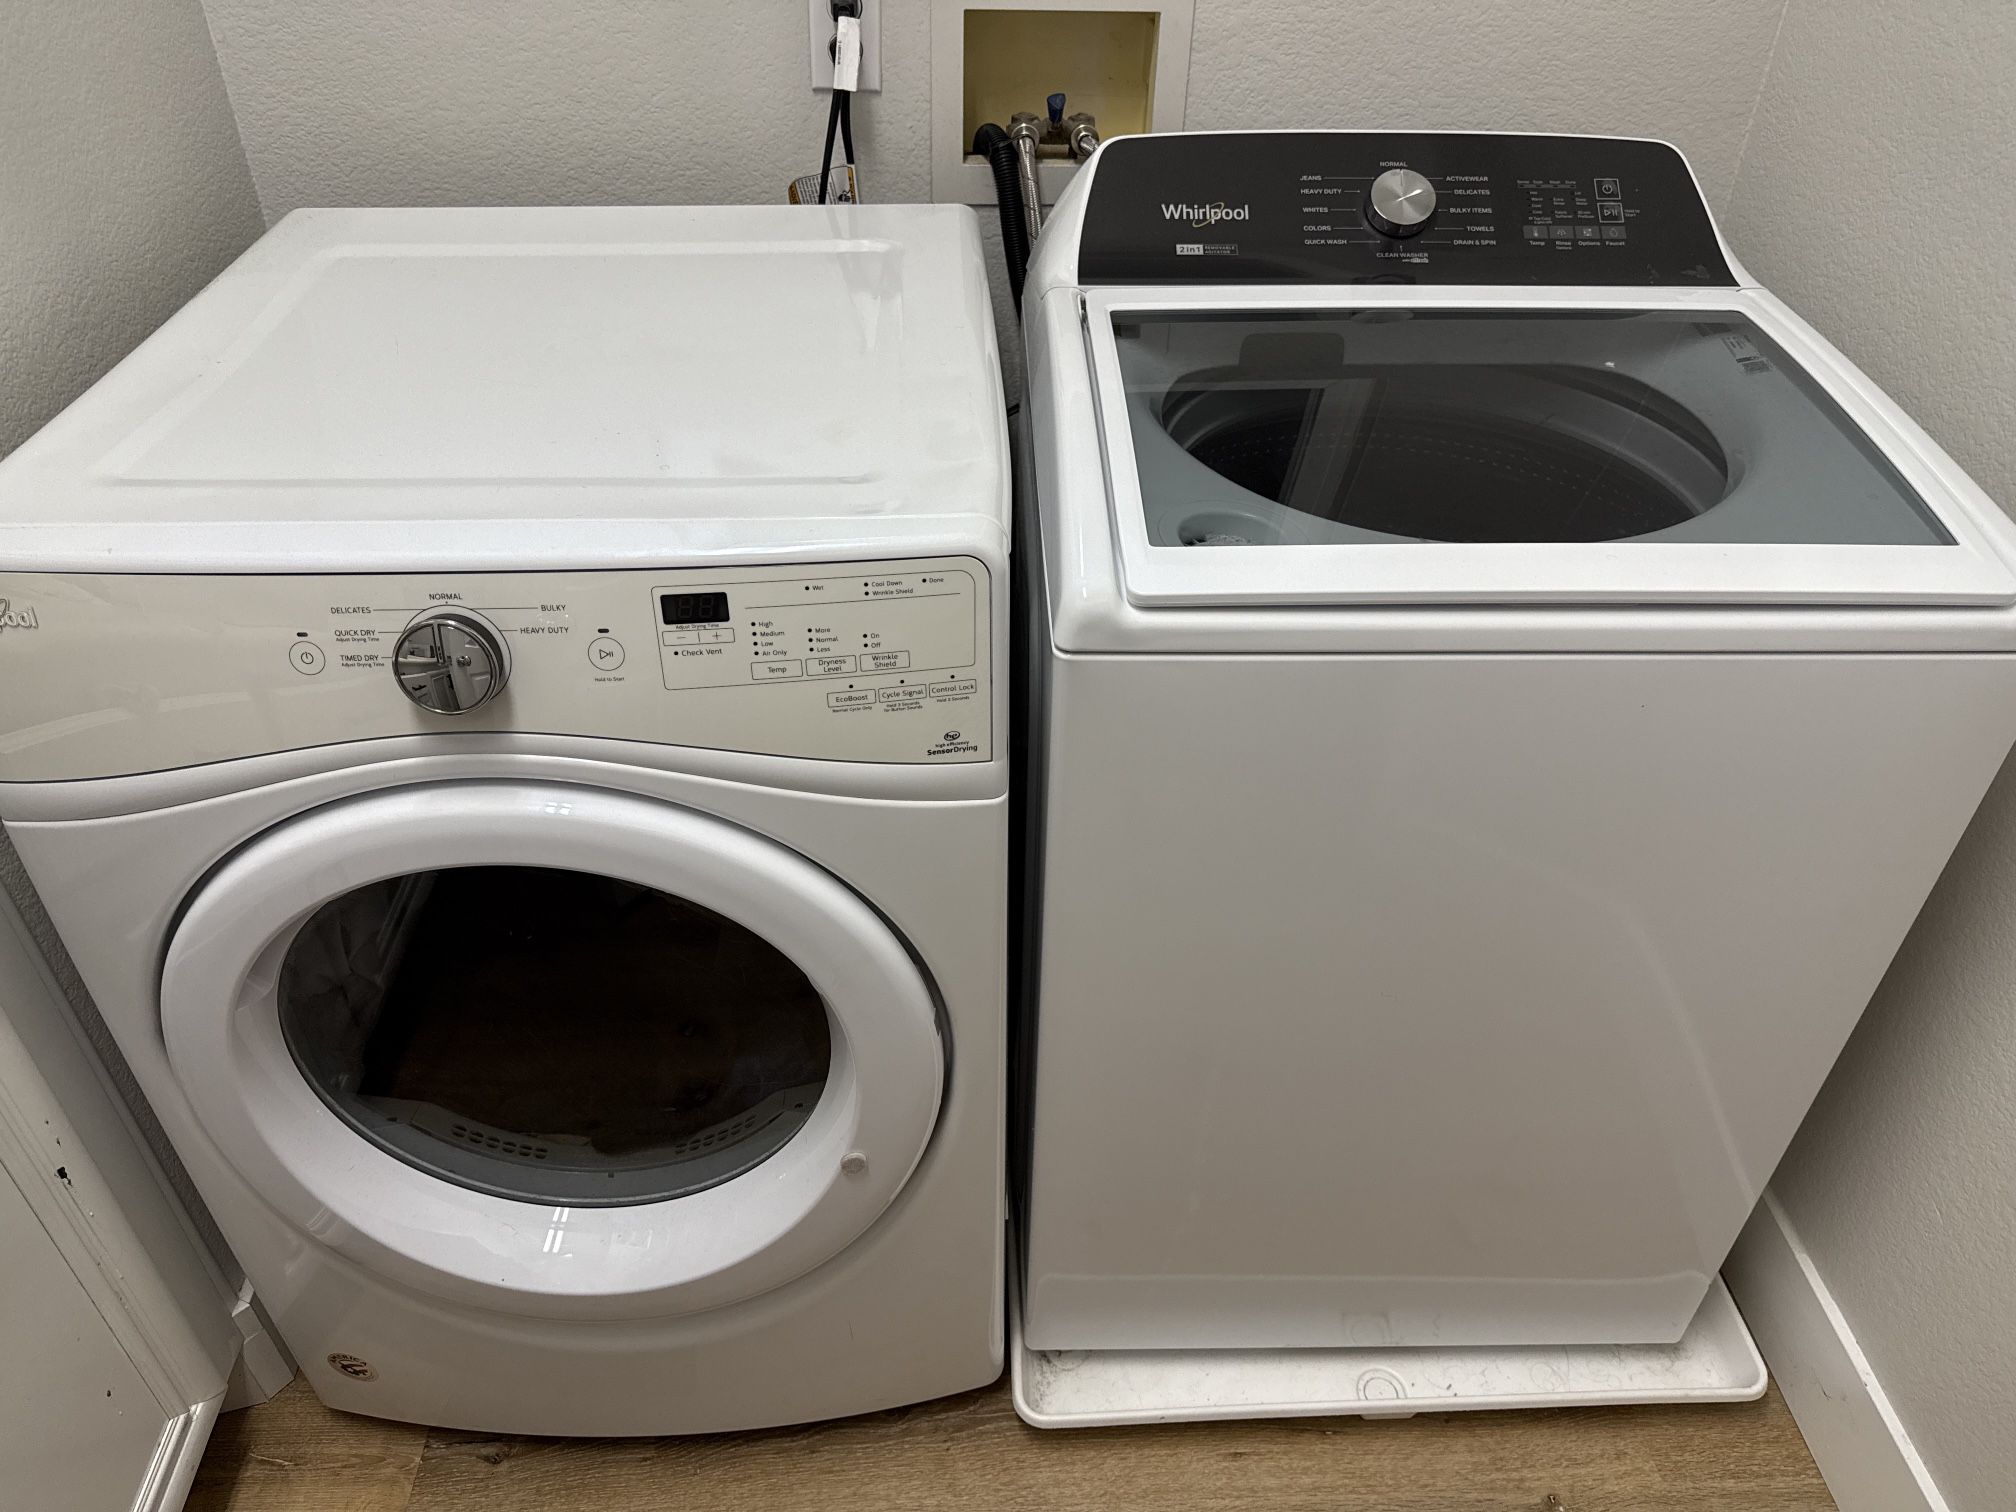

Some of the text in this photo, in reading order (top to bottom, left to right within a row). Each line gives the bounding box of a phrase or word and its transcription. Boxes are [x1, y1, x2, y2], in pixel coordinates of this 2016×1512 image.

[1161, 203, 1249, 225] Whirlpool
[330, 606, 372, 614] DELICATES
[548, 626, 569, 634] DUTY
[818, 658, 847, 667] Dryness
[768, 666, 787, 674] Temp
[882, 688, 924, 699] Cycle Signal
[931, 685, 957, 694] Control
[835, 694, 868, 703] EcoBoost
[927, 744, 978, 756] SensorDrying
